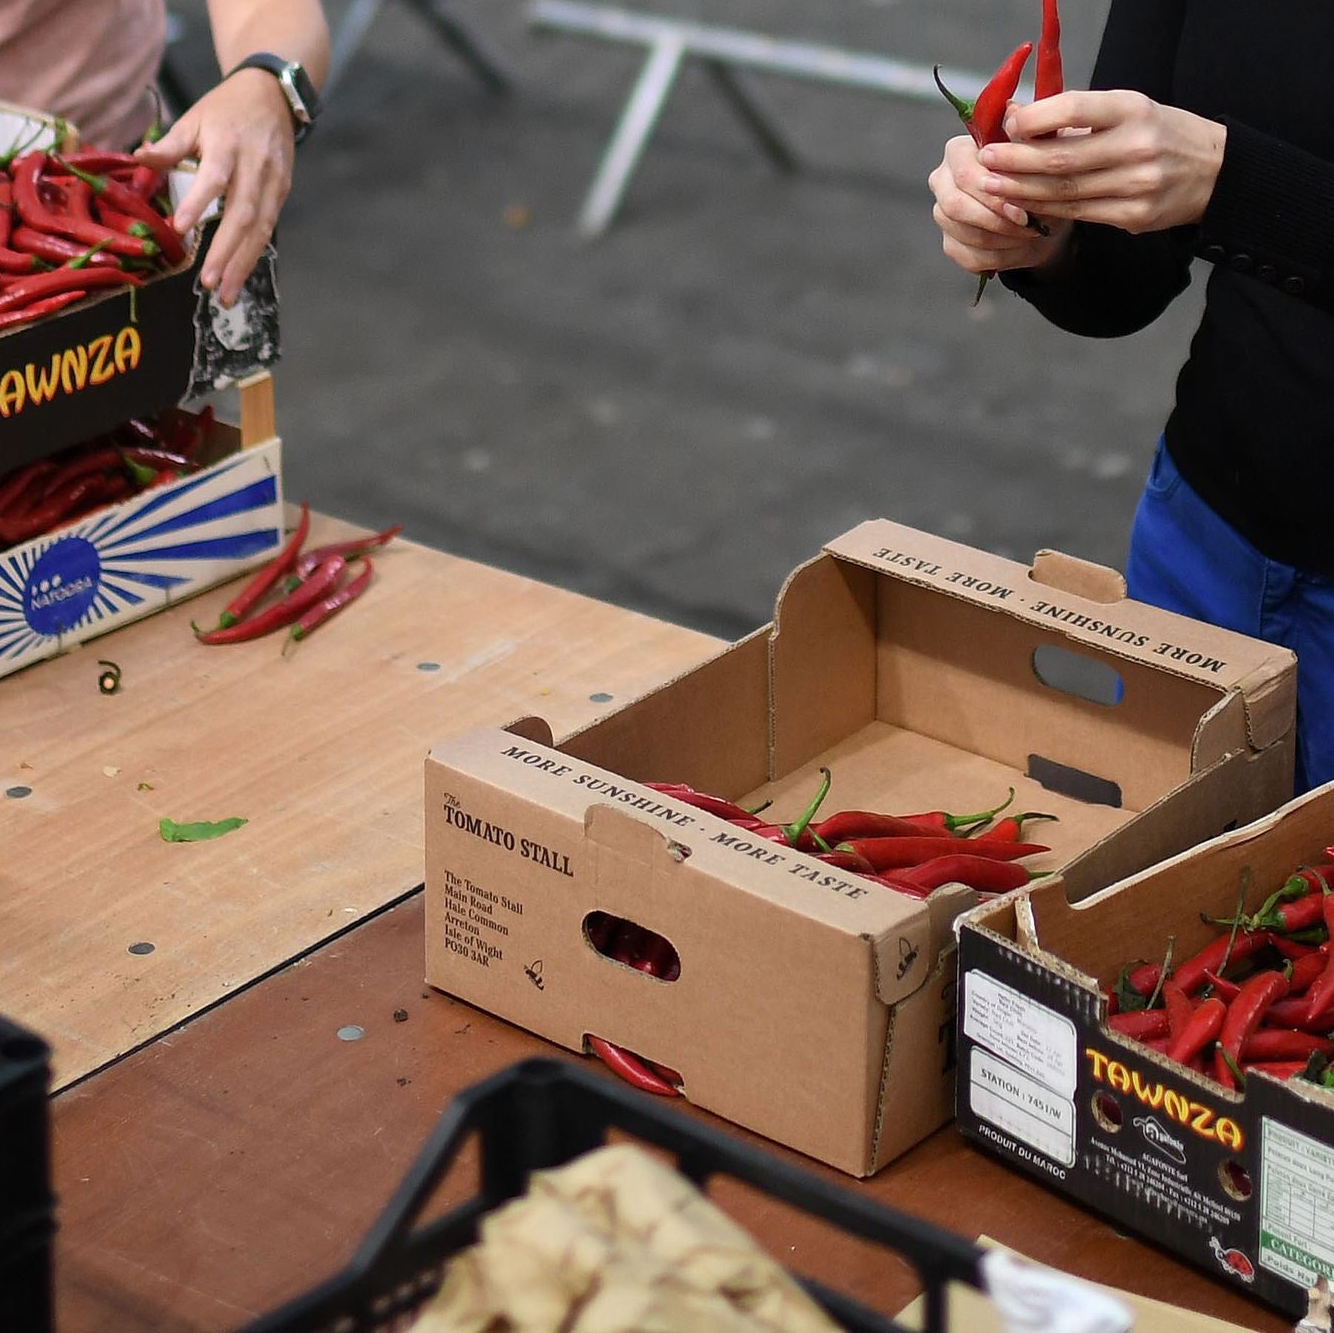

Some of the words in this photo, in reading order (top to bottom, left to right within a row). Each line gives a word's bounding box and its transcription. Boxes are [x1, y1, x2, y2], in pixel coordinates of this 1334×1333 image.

[872, 547, 942, 577] TASTE
[945, 571, 1015, 601] MORE
[1029, 600, 1150, 647] SUNSHINE
[1154, 642, 1227, 673] MORE
[444, 792, 461, 808] The
[500, 745, 573, 778] MORE
[572, 773, 696, 828] SUNSHINE
[708, 833, 787, 867] MORE
[789, 862, 869, 901] TASTE
[444, 804, 515, 851] TOMATO
[521, 838, 574, 877] STALL
[444, 869, 462, 887] The
[464, 879, 499, 904] Tomato
[502, 896, 523, 915] Stall
[444, 884, 467, 904] Main
[470, 897, 492, 915] Road
[444, 898, 466, 916] Hale
[469, 910, 509, 936] Common
[444, 912, 480, 936] Arreton
[444, 937, 469, 958] PO30
[471, 948, 490, 967] 3AR
[445, 925, 462, 941] Isle
[464, 933, 474, 947] of
[476, 939, 503, 960] Wight
[981, 1068, 1021, 1100] STATION
[1085, 1046, 1245, 1153] TAWNZA
[979, 1124, 1017, 1156] PRODUIT
[1018, 1146, 1032, 1160] DU
[1032, 1153, 1066, 1179] MAROC
